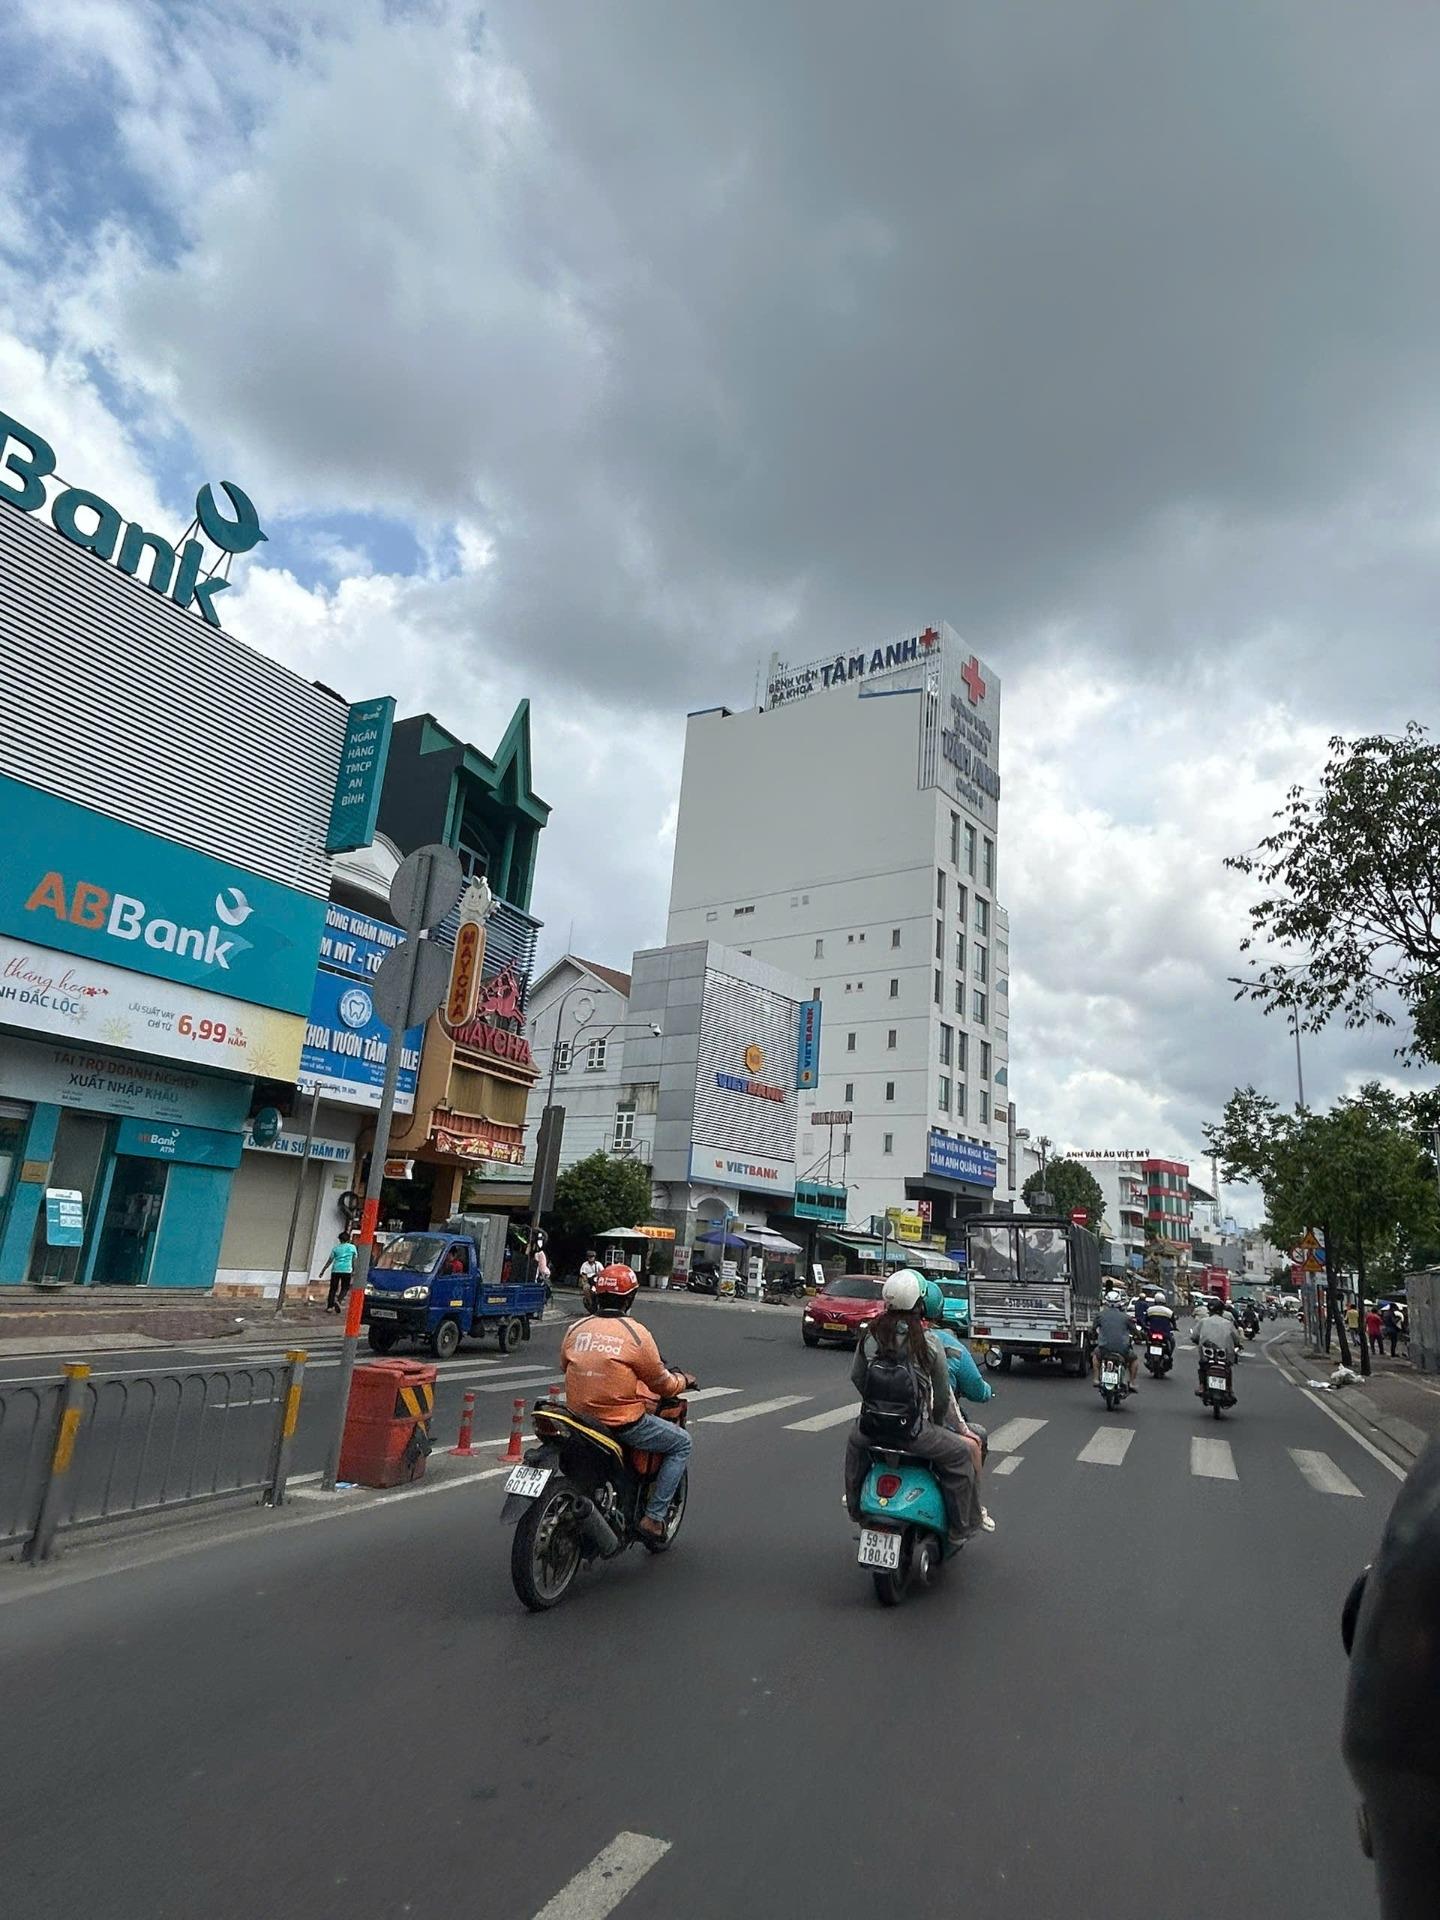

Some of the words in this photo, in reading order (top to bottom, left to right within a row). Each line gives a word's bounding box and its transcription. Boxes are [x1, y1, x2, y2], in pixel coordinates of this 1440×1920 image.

[0, 411, 232, 627] Bank
[820, 654, 865, 689] TÂM
[869, 637, 917, 673] ANH
[350, 728, 378, 743] NGÂN
[347, 745, 375, 760] HÀNG
[345, 761, 372, 774] TMCP
[348, 778, 363, 789] AN
[341, 792, 365, 806] BÌNH
[25, 871, 235, 970] ABBank
[349, 918, 378, 942] KHÁM
[377, 929, 397, 949] NHA
[334, 941, 357, 964] MỸ
[19, 988, 50, 1008] ĐẮC
[52, 997, 80, 1015] LỘC
[161, 1011, 175, 1020] VAY
[178, 1014, 227, 1043] 6,99
[804, 1007, 814, 1068] VIETBANK
[452, 1022, 532, 1066] MAYCHA
[107, 1062, 153, 1081] DOANH
[68, 1073, 105, 1090] XUẤT
[107, 1080, 144, 1098] NHẬP
[717, 1072, 785, 1103] VIETBANK
[726, 1161, 779, 1180] VIETBANK
[930, 1151, 945, 1167] TÂM
[945, 1156, 959, 1170] ANH
[977, 1165, 982, 1176] 8
[590, 1341, 622, 1355] Food
[516, 1467, 544, 1482] 60-B5
[863, 1547, 896, 1566] 180.49
